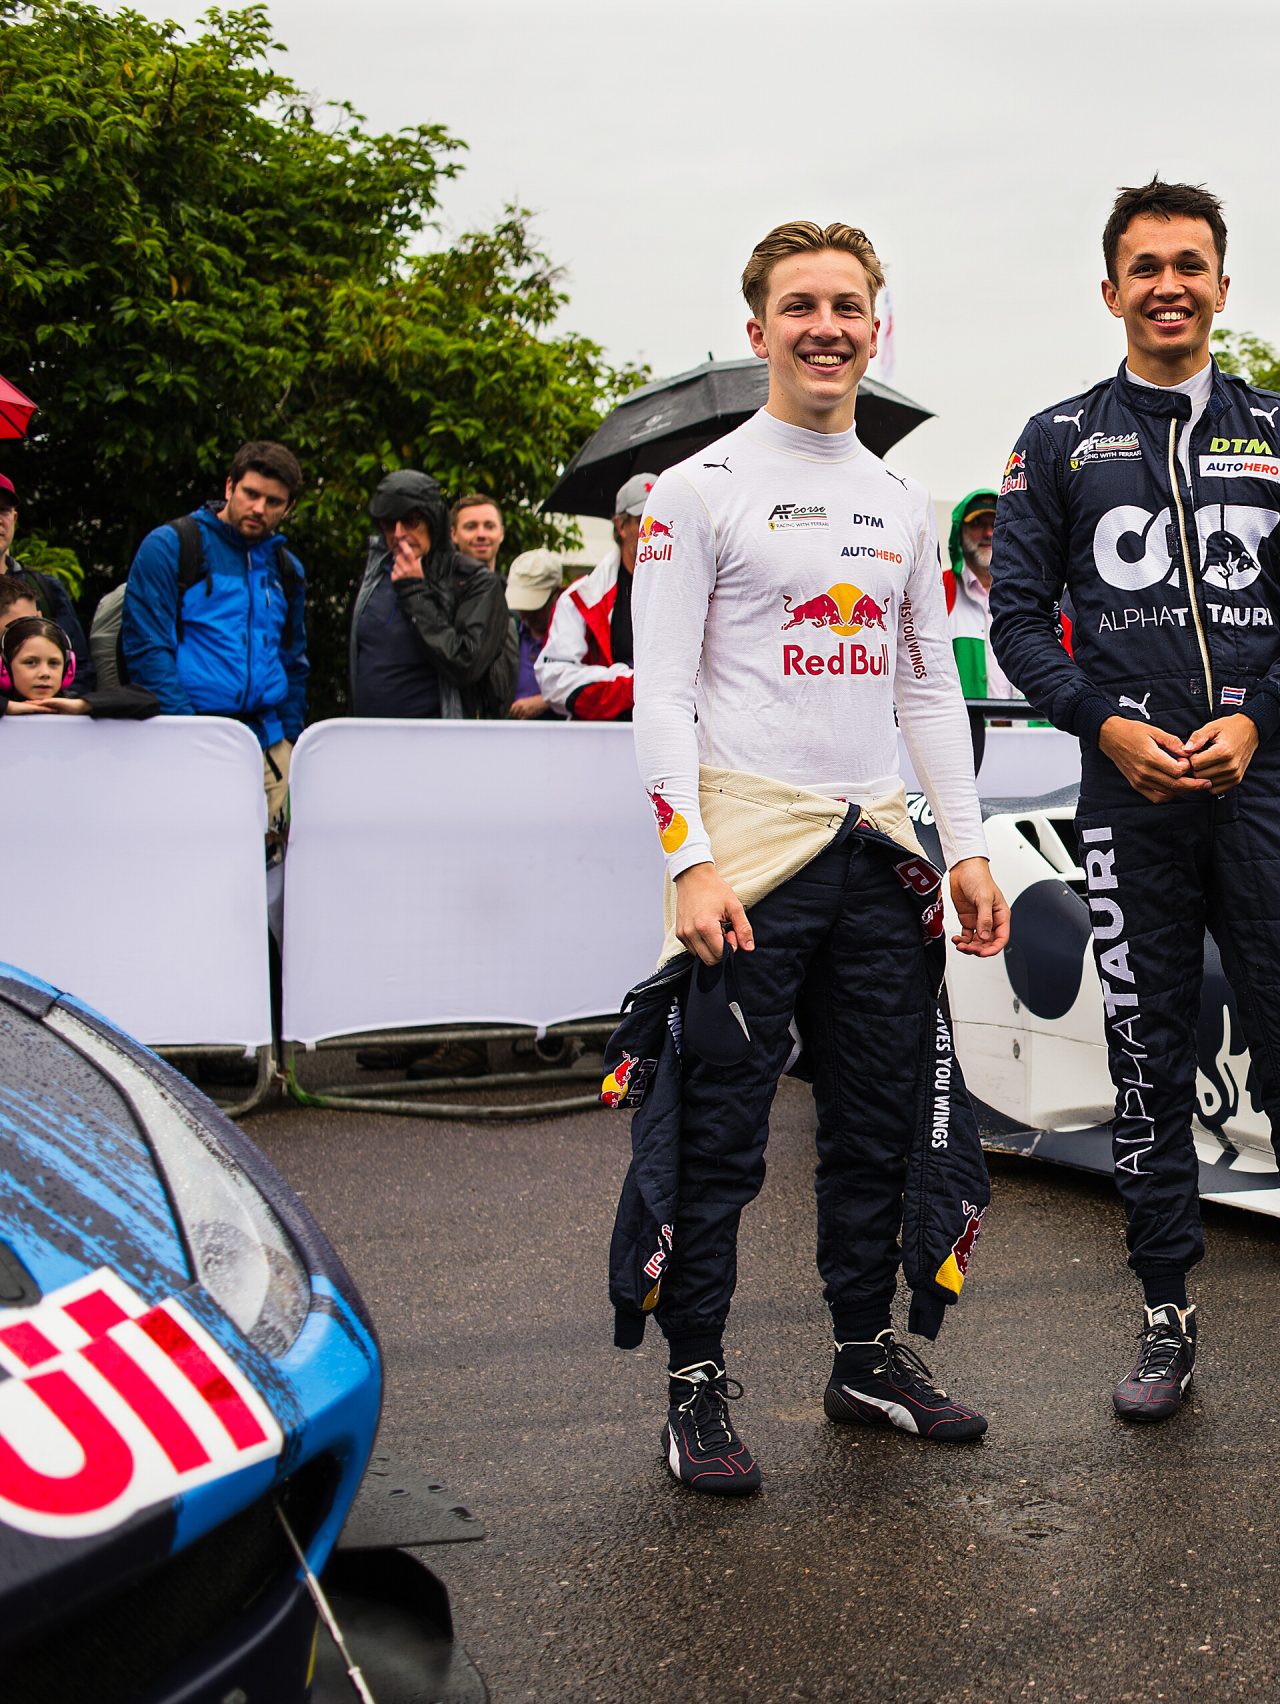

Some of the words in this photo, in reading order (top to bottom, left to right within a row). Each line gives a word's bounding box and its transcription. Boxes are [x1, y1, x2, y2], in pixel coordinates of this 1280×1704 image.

[1209, 437, 1272, 455] DTM
[1206, 462, 1279, 476] AUTOHERO
[853, 513, 884, 529] DTM
[840, 546, 903, 565] AUTOHERO
[903, 617, 917, 642] YOU
[783, 643, 844, 676] Red
[850, 643, 889, 676] Bull
[907, 641, 928, 680] WINGS
[1080, 826, 1154, 1177] ALPHATAURI
[934, 1056, 953, 1091] YOU
[931, 1095, 951, 1149] WINGS
